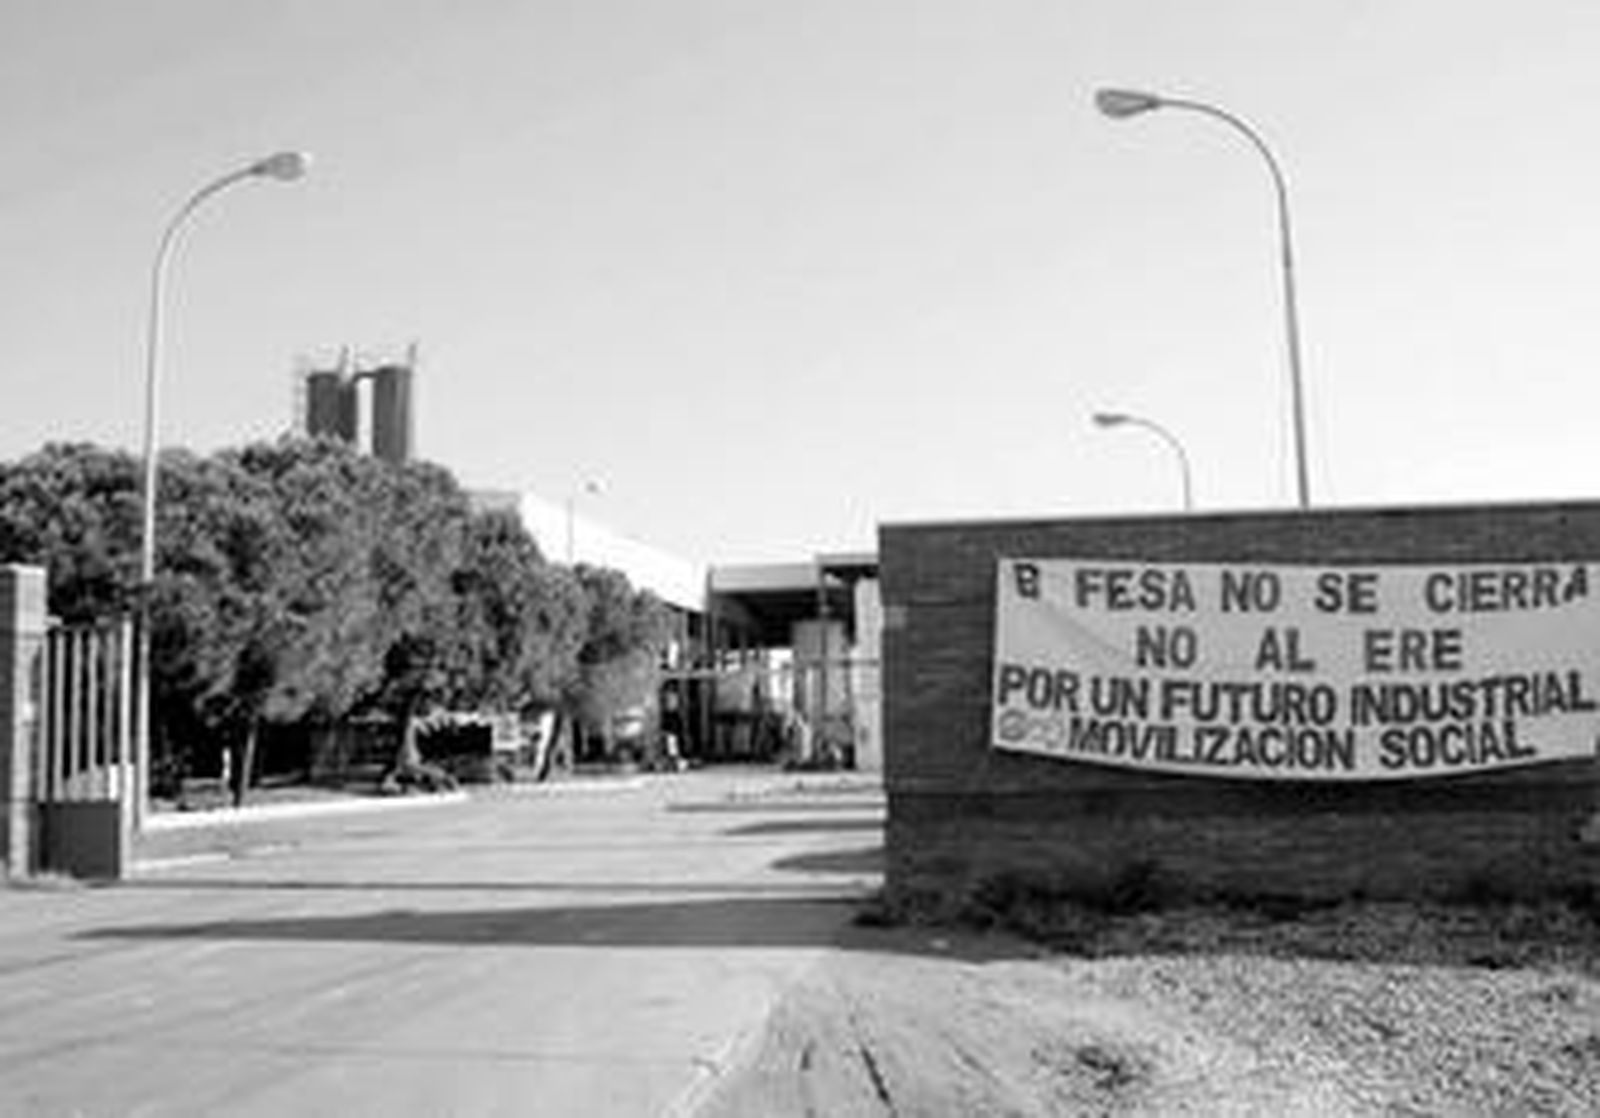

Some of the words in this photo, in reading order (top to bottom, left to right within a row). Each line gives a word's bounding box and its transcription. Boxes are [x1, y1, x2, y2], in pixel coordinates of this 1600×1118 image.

[1075, 569, 1196, 612] FESA
[1222, 570, 1280, 612] NO
[1314, 572, 1378, 613] SE
[1425, 566, 1588, 612] CIERRA
[1136, 625, 1197, 668] NO
[1255, 628, 1315, 672] AL
[1364, 629, 1461, 671] ERE
[999, 664, 1078, 711] POR
[1091, 677, 1149, 718] UN
[1160, 681, 1336, 726] FUTURO
[1350, 669, 1596, 726] INDUSTRIAL
[1379, 721, 1536, 769] SOCIAL
